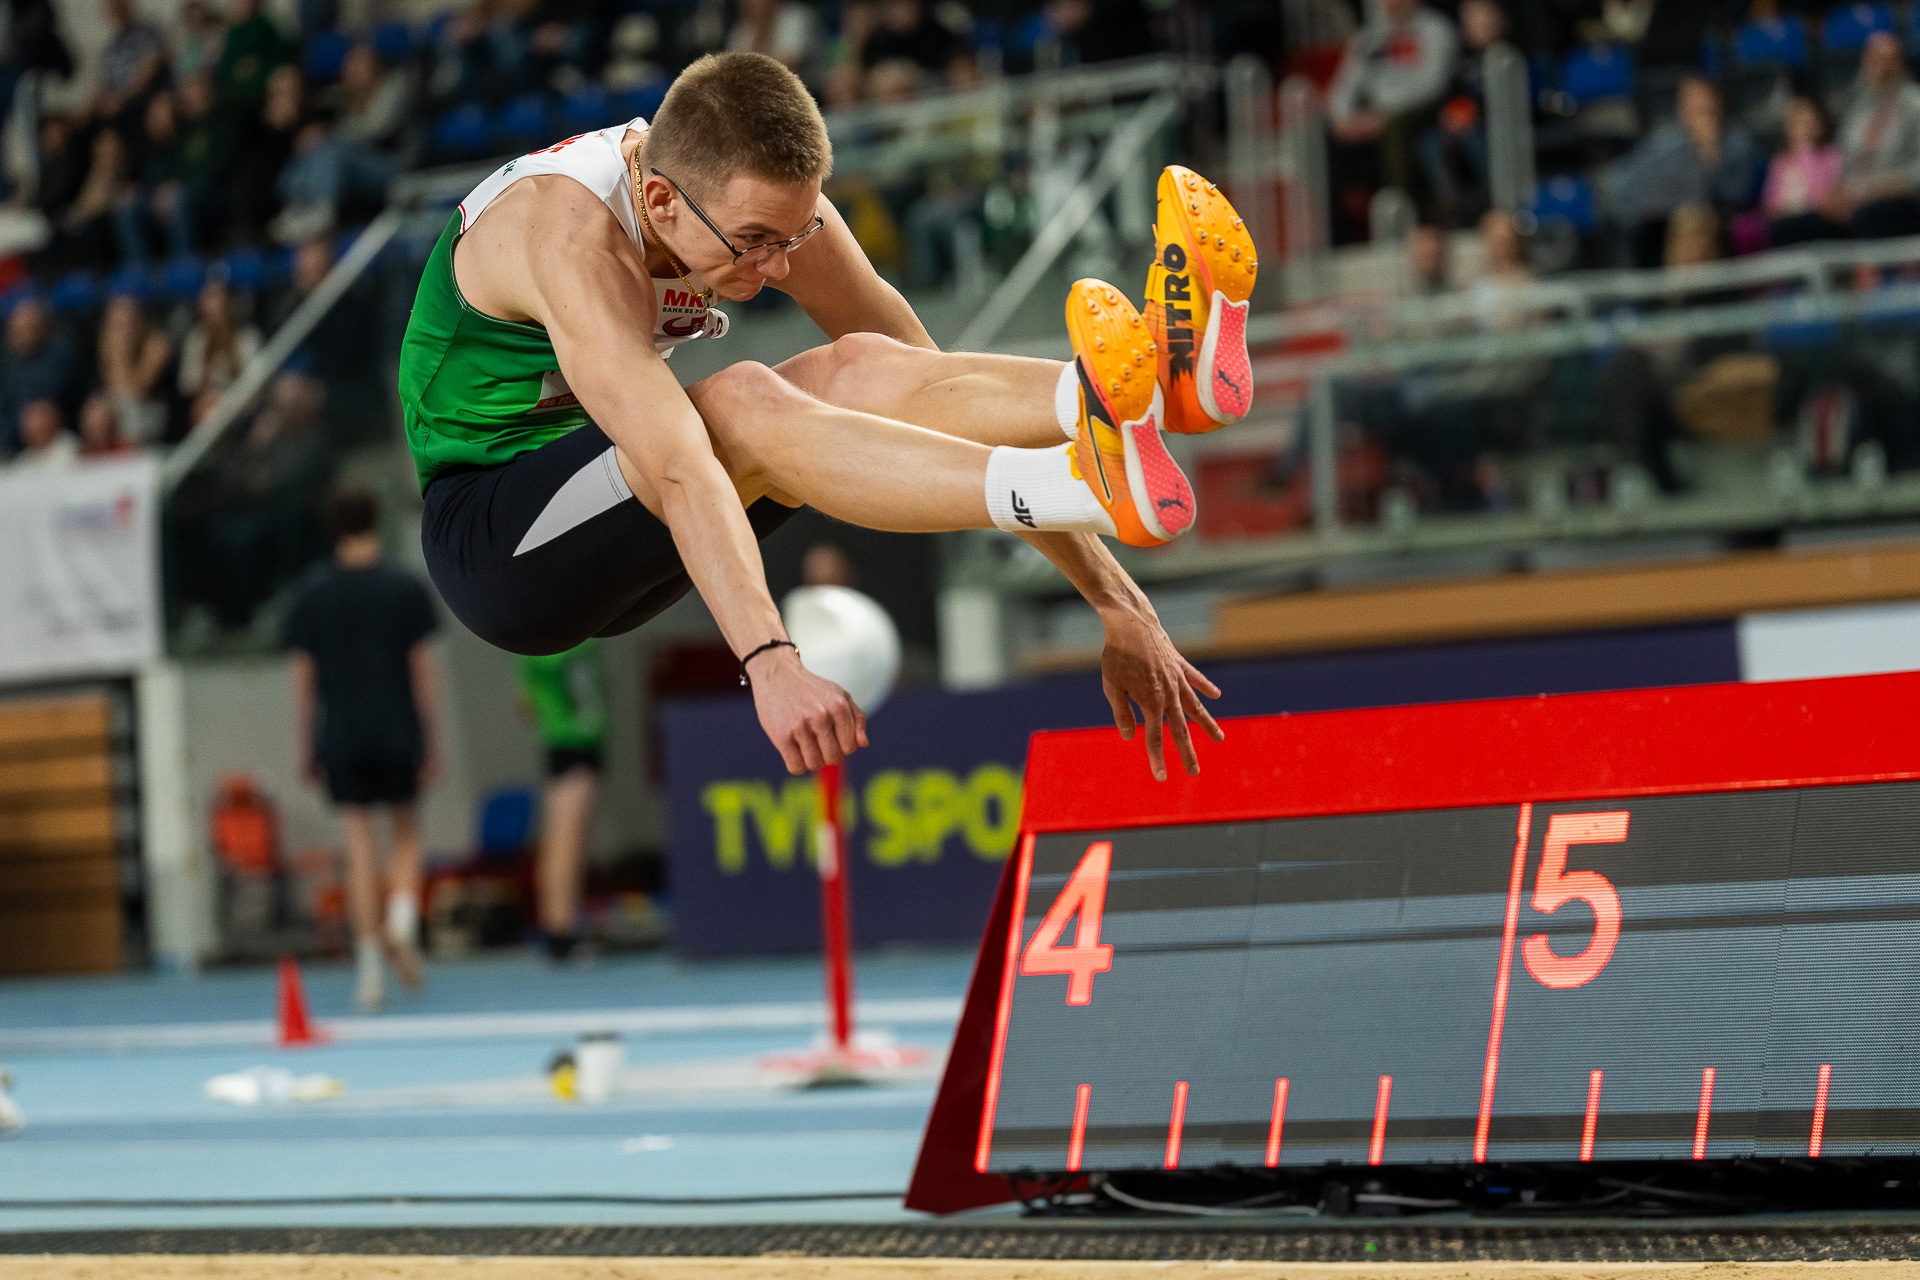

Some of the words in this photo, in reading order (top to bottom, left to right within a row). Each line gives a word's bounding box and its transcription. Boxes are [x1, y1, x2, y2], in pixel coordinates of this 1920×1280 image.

[1163, 243, 1194, 389] NITRO
[1020, 840, 1115, 1006] 4
[1521, 810, 1631, 989] 5
